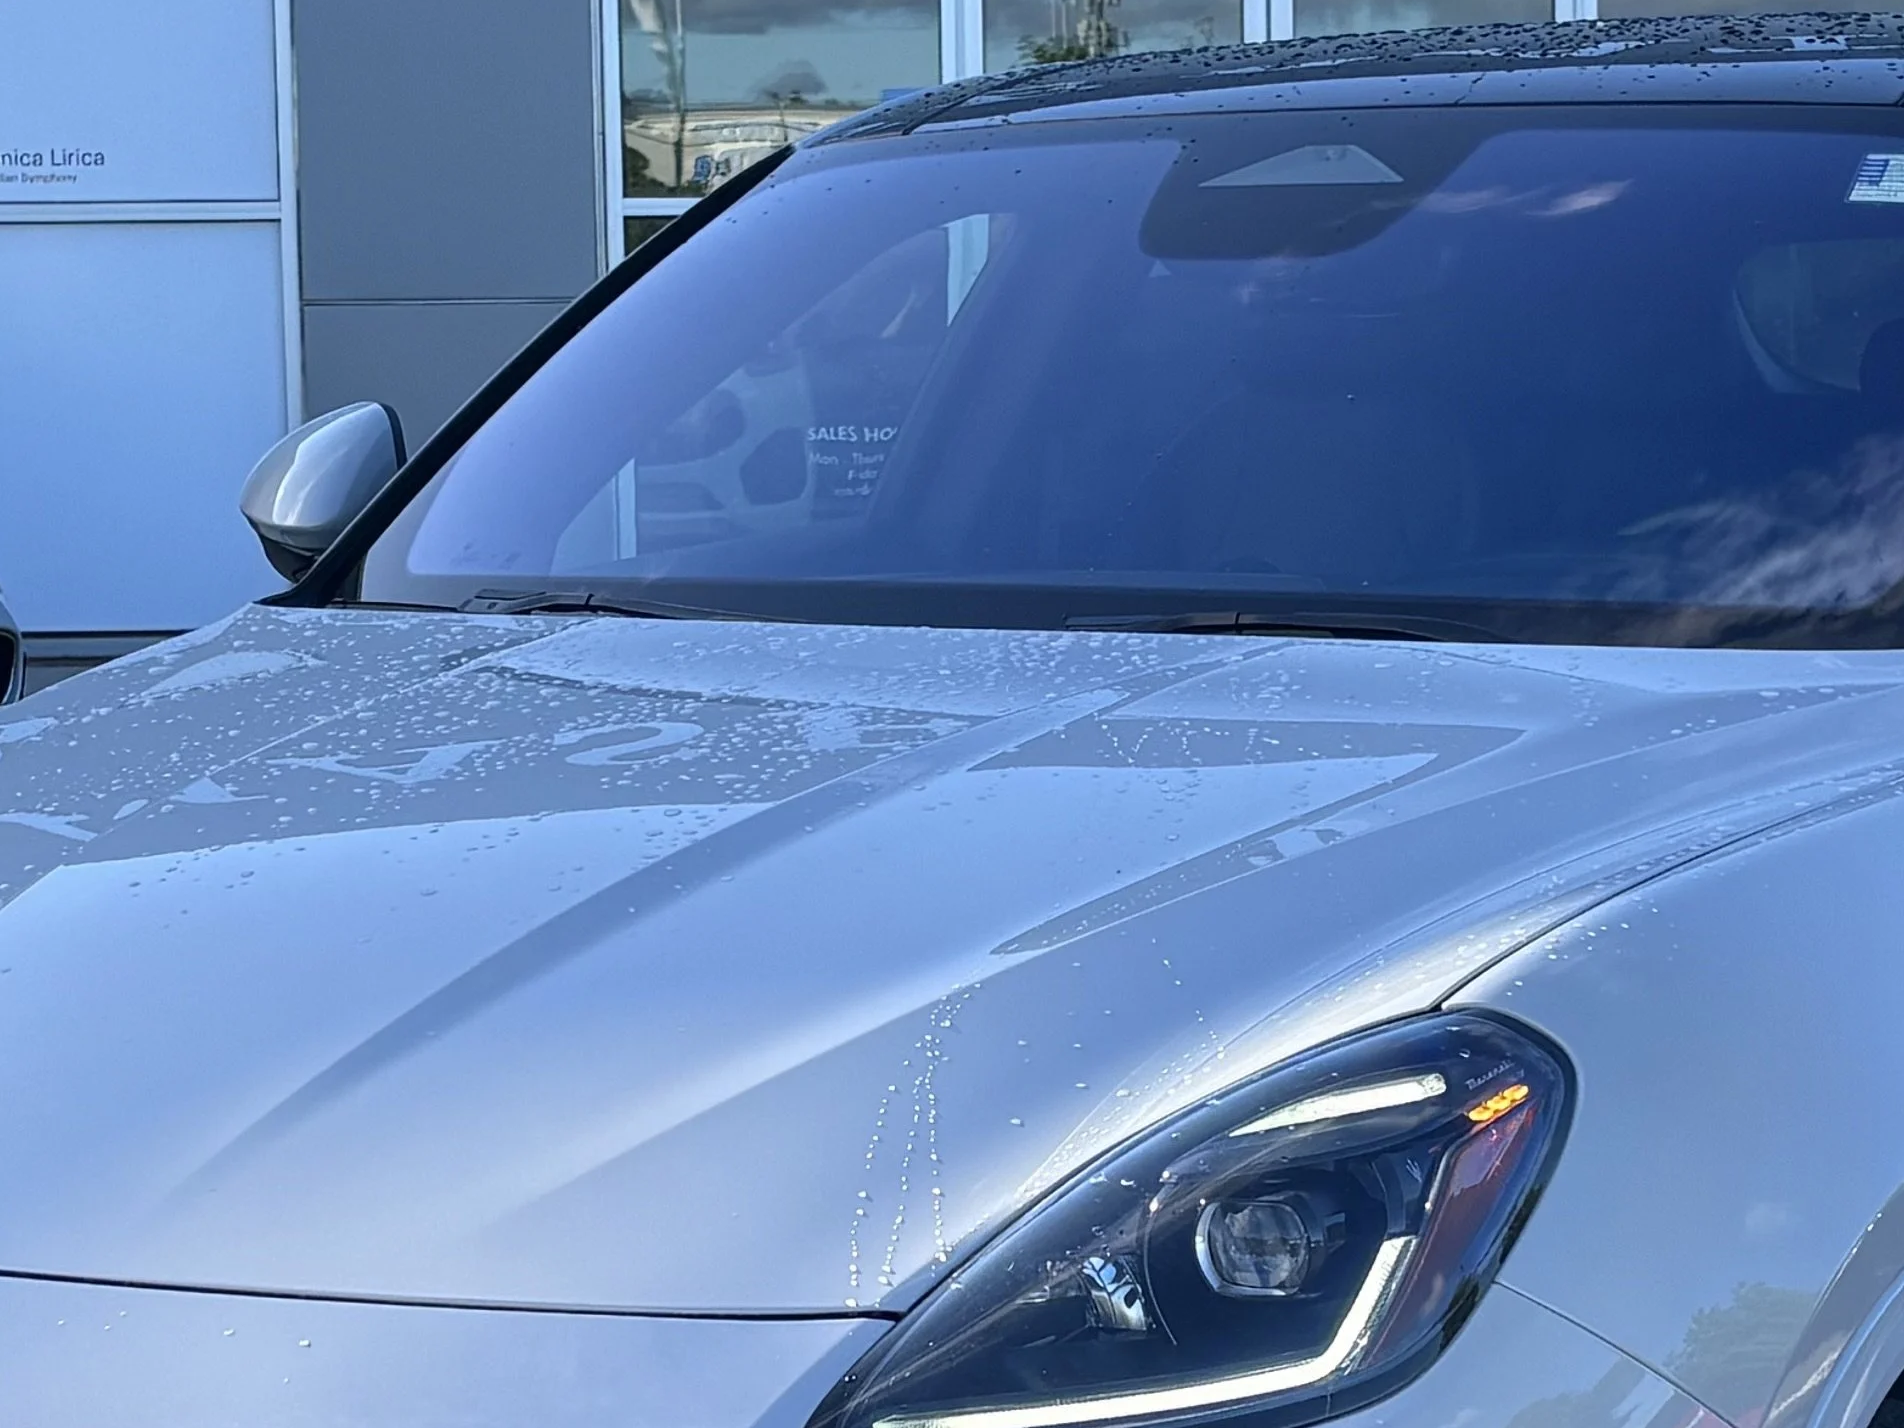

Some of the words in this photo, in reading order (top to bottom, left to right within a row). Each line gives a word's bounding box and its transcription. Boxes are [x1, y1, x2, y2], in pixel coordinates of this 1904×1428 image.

[50, 148, 106, 167] Lirica
[807, 425, 858, 442] SALES
[863, 426, 898, 443] HO
